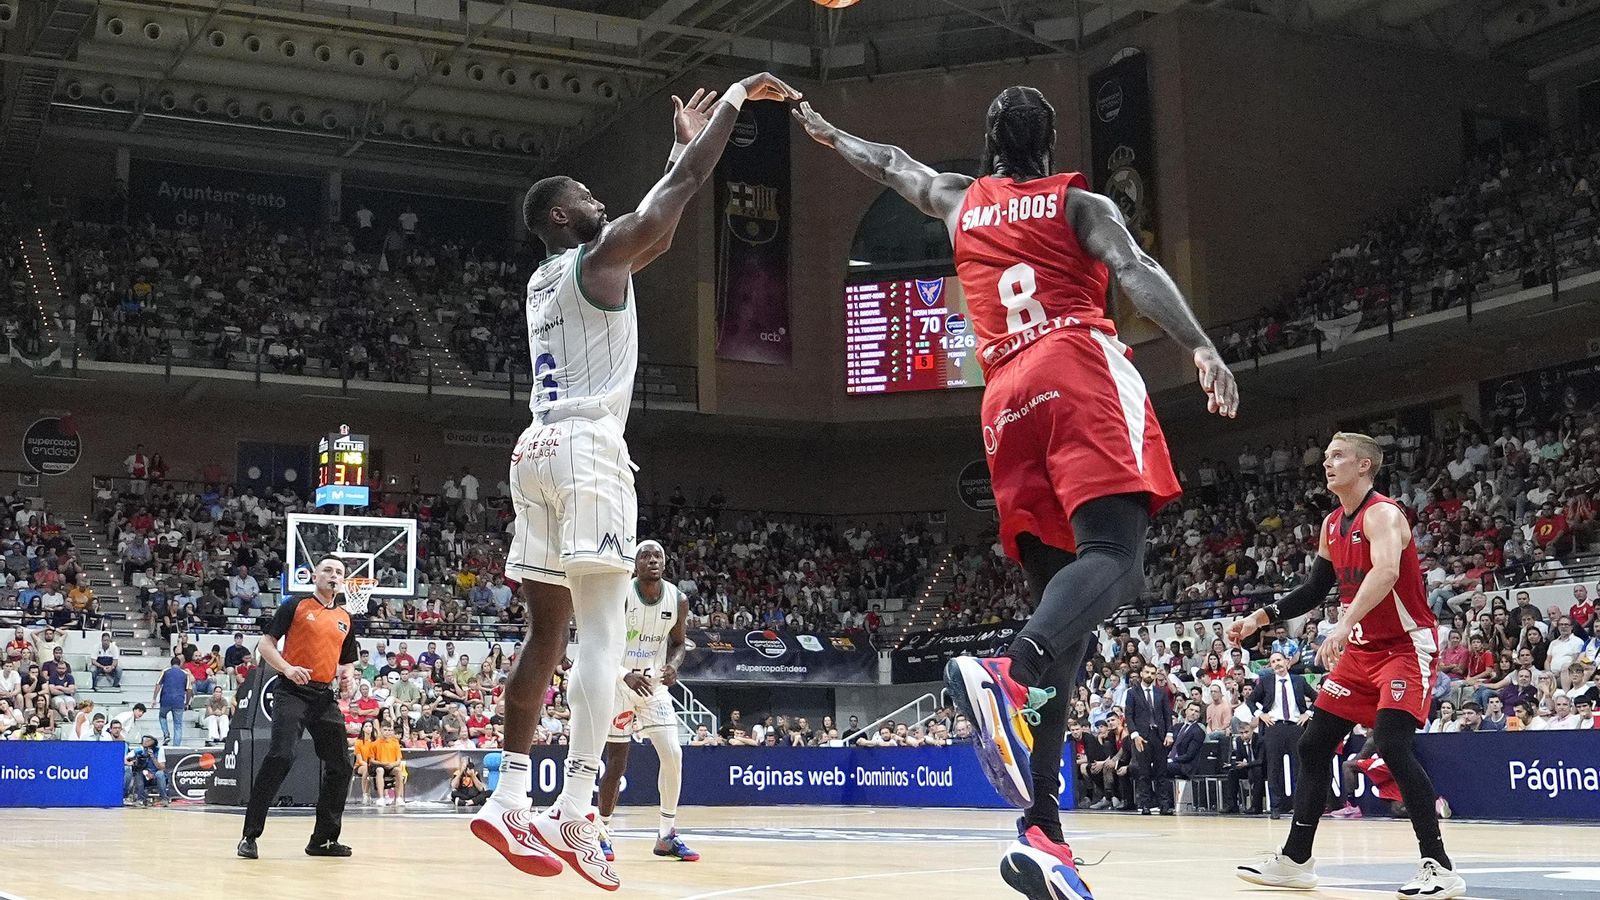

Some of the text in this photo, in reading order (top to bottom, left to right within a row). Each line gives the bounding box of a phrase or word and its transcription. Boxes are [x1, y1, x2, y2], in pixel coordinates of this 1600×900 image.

[962, 193, 1057, 231] SANT-ROOS
[998, 262, 1046, 334] 8
[920, 316, 940, 334] 70
[760, 330, 782, 342] acb
[939, 335, 975, 349] 1:26
[922, 358, 927, 367] 5
[954, 358, 960, 368] 4
[1028, 390, 1060, 408] MURCIA
[27, 437, 77, 448] supercopa
[334, 442, 364, 451] LOTUS
[540, 438, 559, 446] SOL
[31, 446, 77, 457] endesa
[334, 464, 362, 485] 3.1
[736, 664, 807, 674] #SupercopaEndesa
[225, 751, 236, 769] acb
[46, 765, 89, 780] Cloud
[729, 764, 953, 791] Páginas web Dominios Cloud
[1509, 759, 1600, 798] Página
